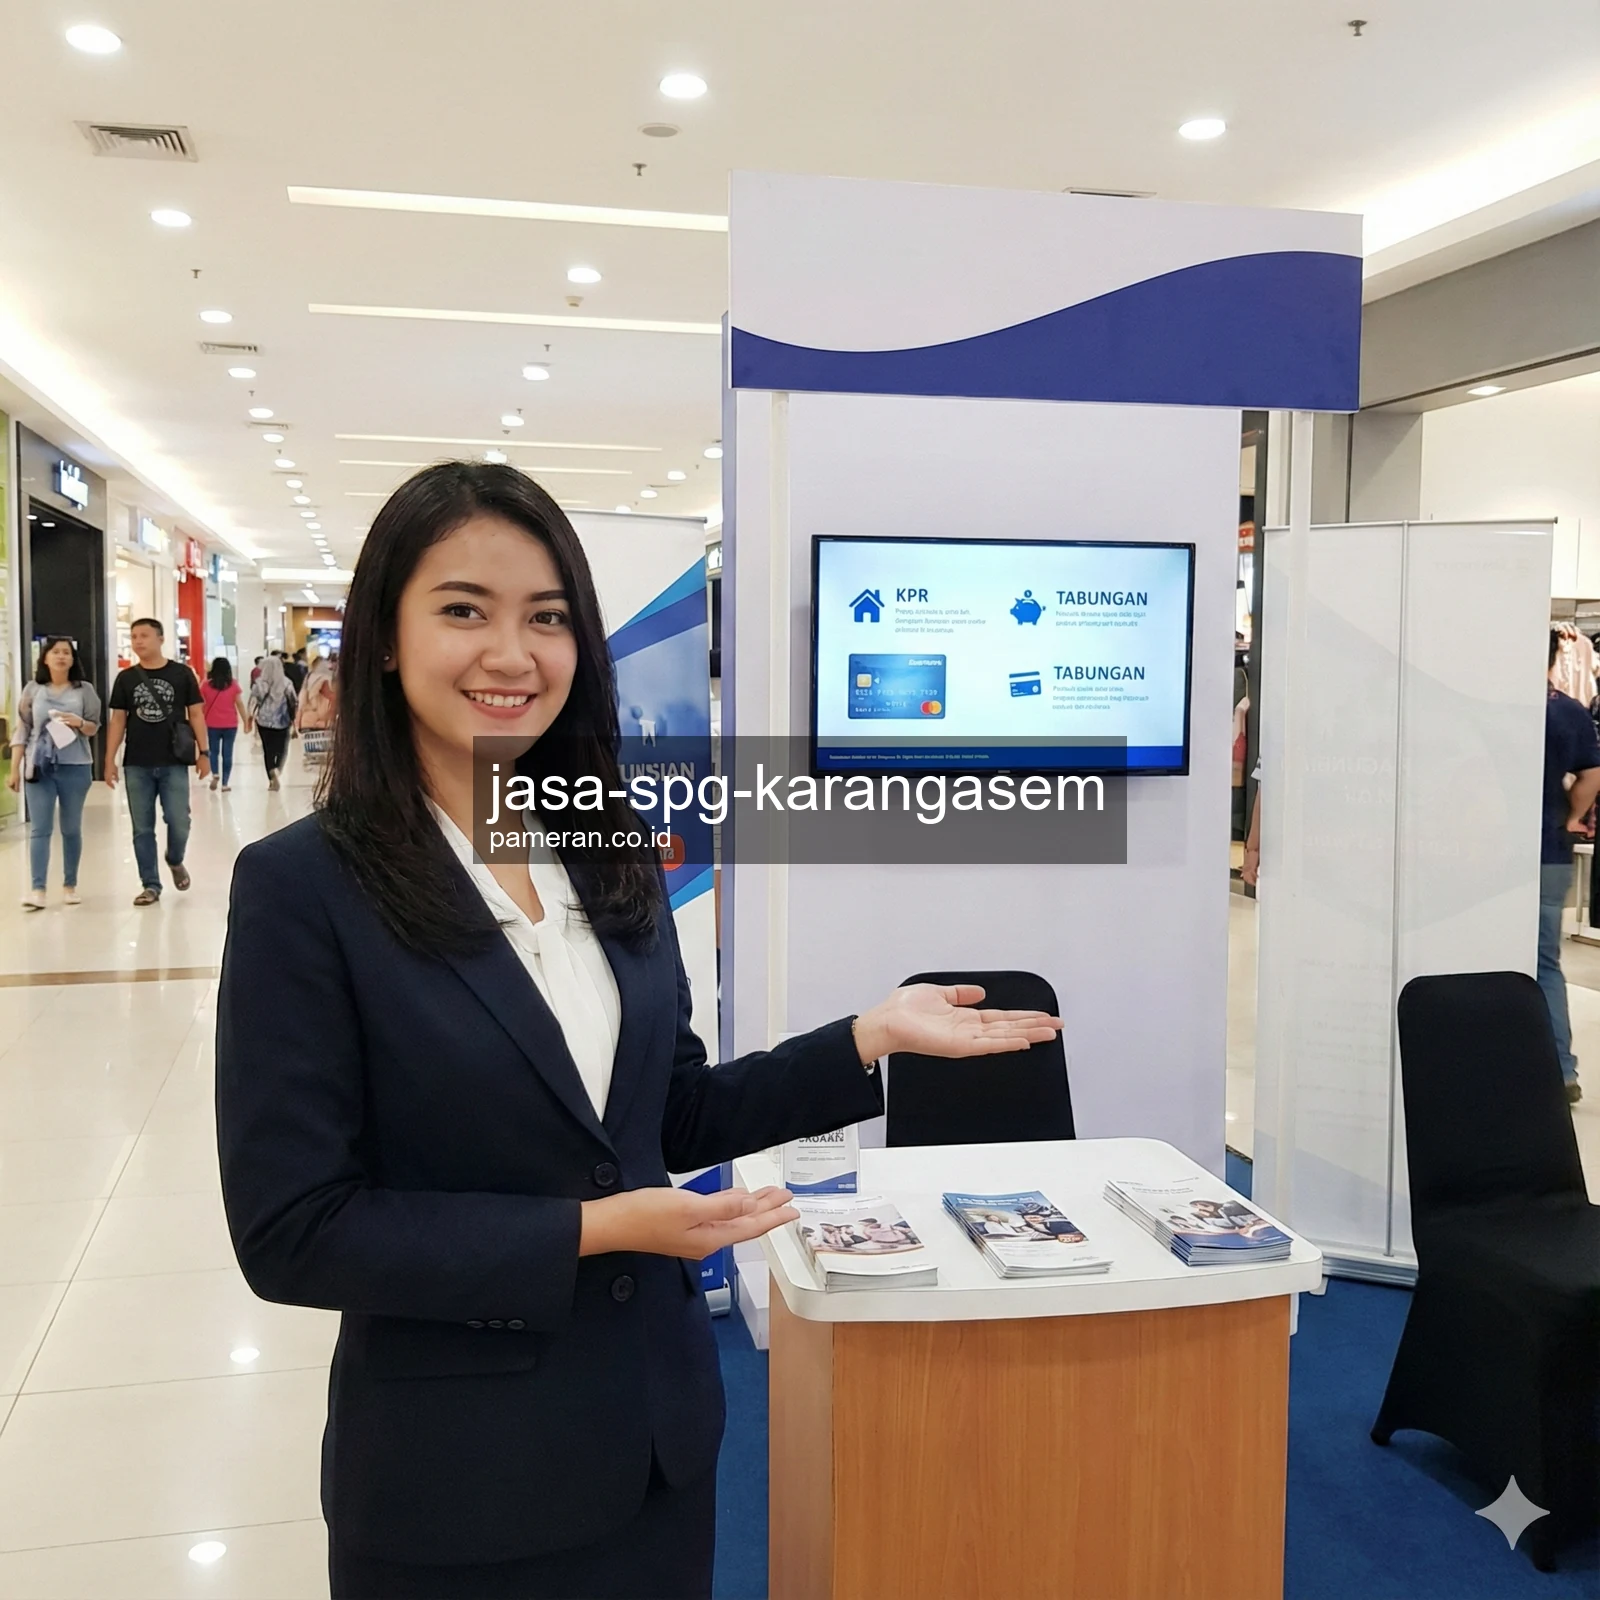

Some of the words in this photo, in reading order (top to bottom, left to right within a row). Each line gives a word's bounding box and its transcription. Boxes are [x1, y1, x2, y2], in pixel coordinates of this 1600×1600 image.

[896, 588, 928, 603] KPR
[1056, 591, 1148, 606] TABUNGAN
[1053, 666, 1145, 680] TABUNGAN
